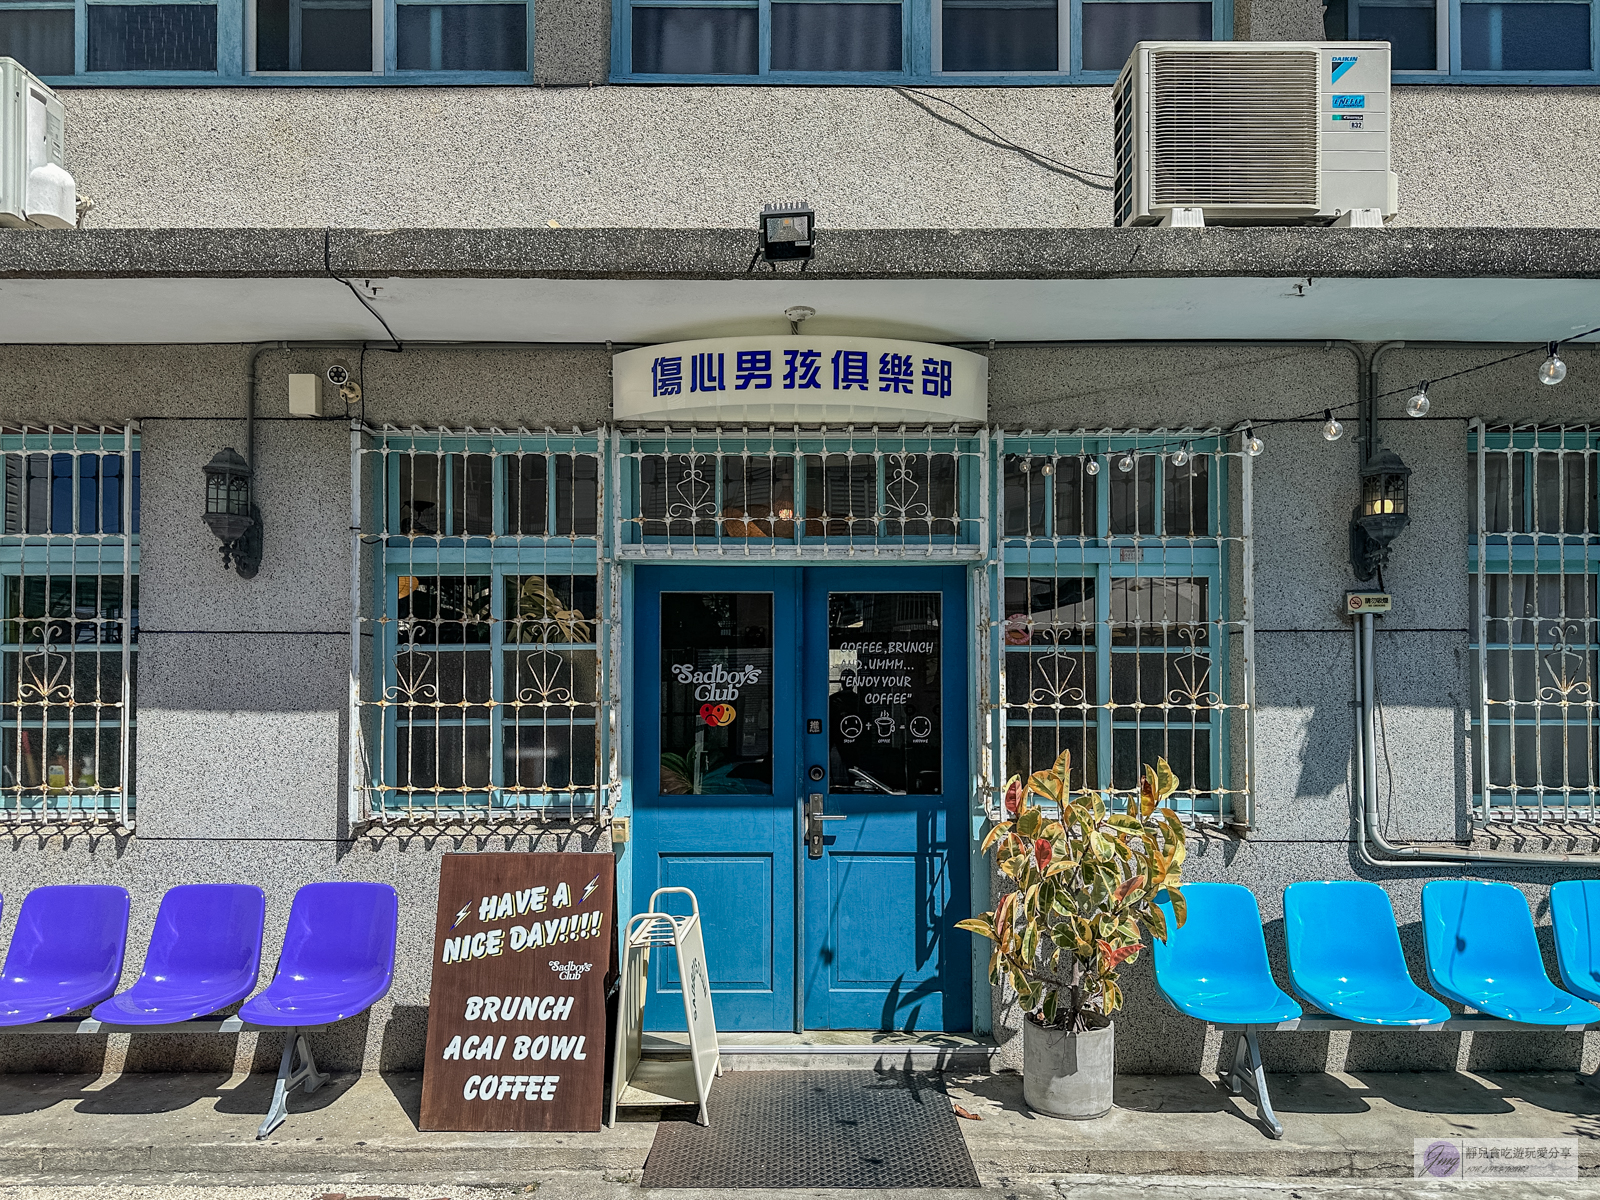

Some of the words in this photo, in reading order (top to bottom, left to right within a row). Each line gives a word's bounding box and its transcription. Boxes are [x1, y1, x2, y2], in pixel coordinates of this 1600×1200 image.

[651, 349, 952, 398] 傷心男孩俱樂部
[694, 683, 739, 702] Club
[881, 676, 912, 688] YOUR
[478, 886, 549, 923] HAVE
[552, 882, 572, 909] A
[442, 929, 505, 965] NICE
[509, 910, 603, 953] DAY!!!!
[558, 972, 581, 981] Club
[464, 995, 575, 1023] BRUNCH
[442, 1035, 507, 1061] ACAI
[512, 1035, 587, 1061] BOWL
[463, 1074, 560, 1101] COFFEE
